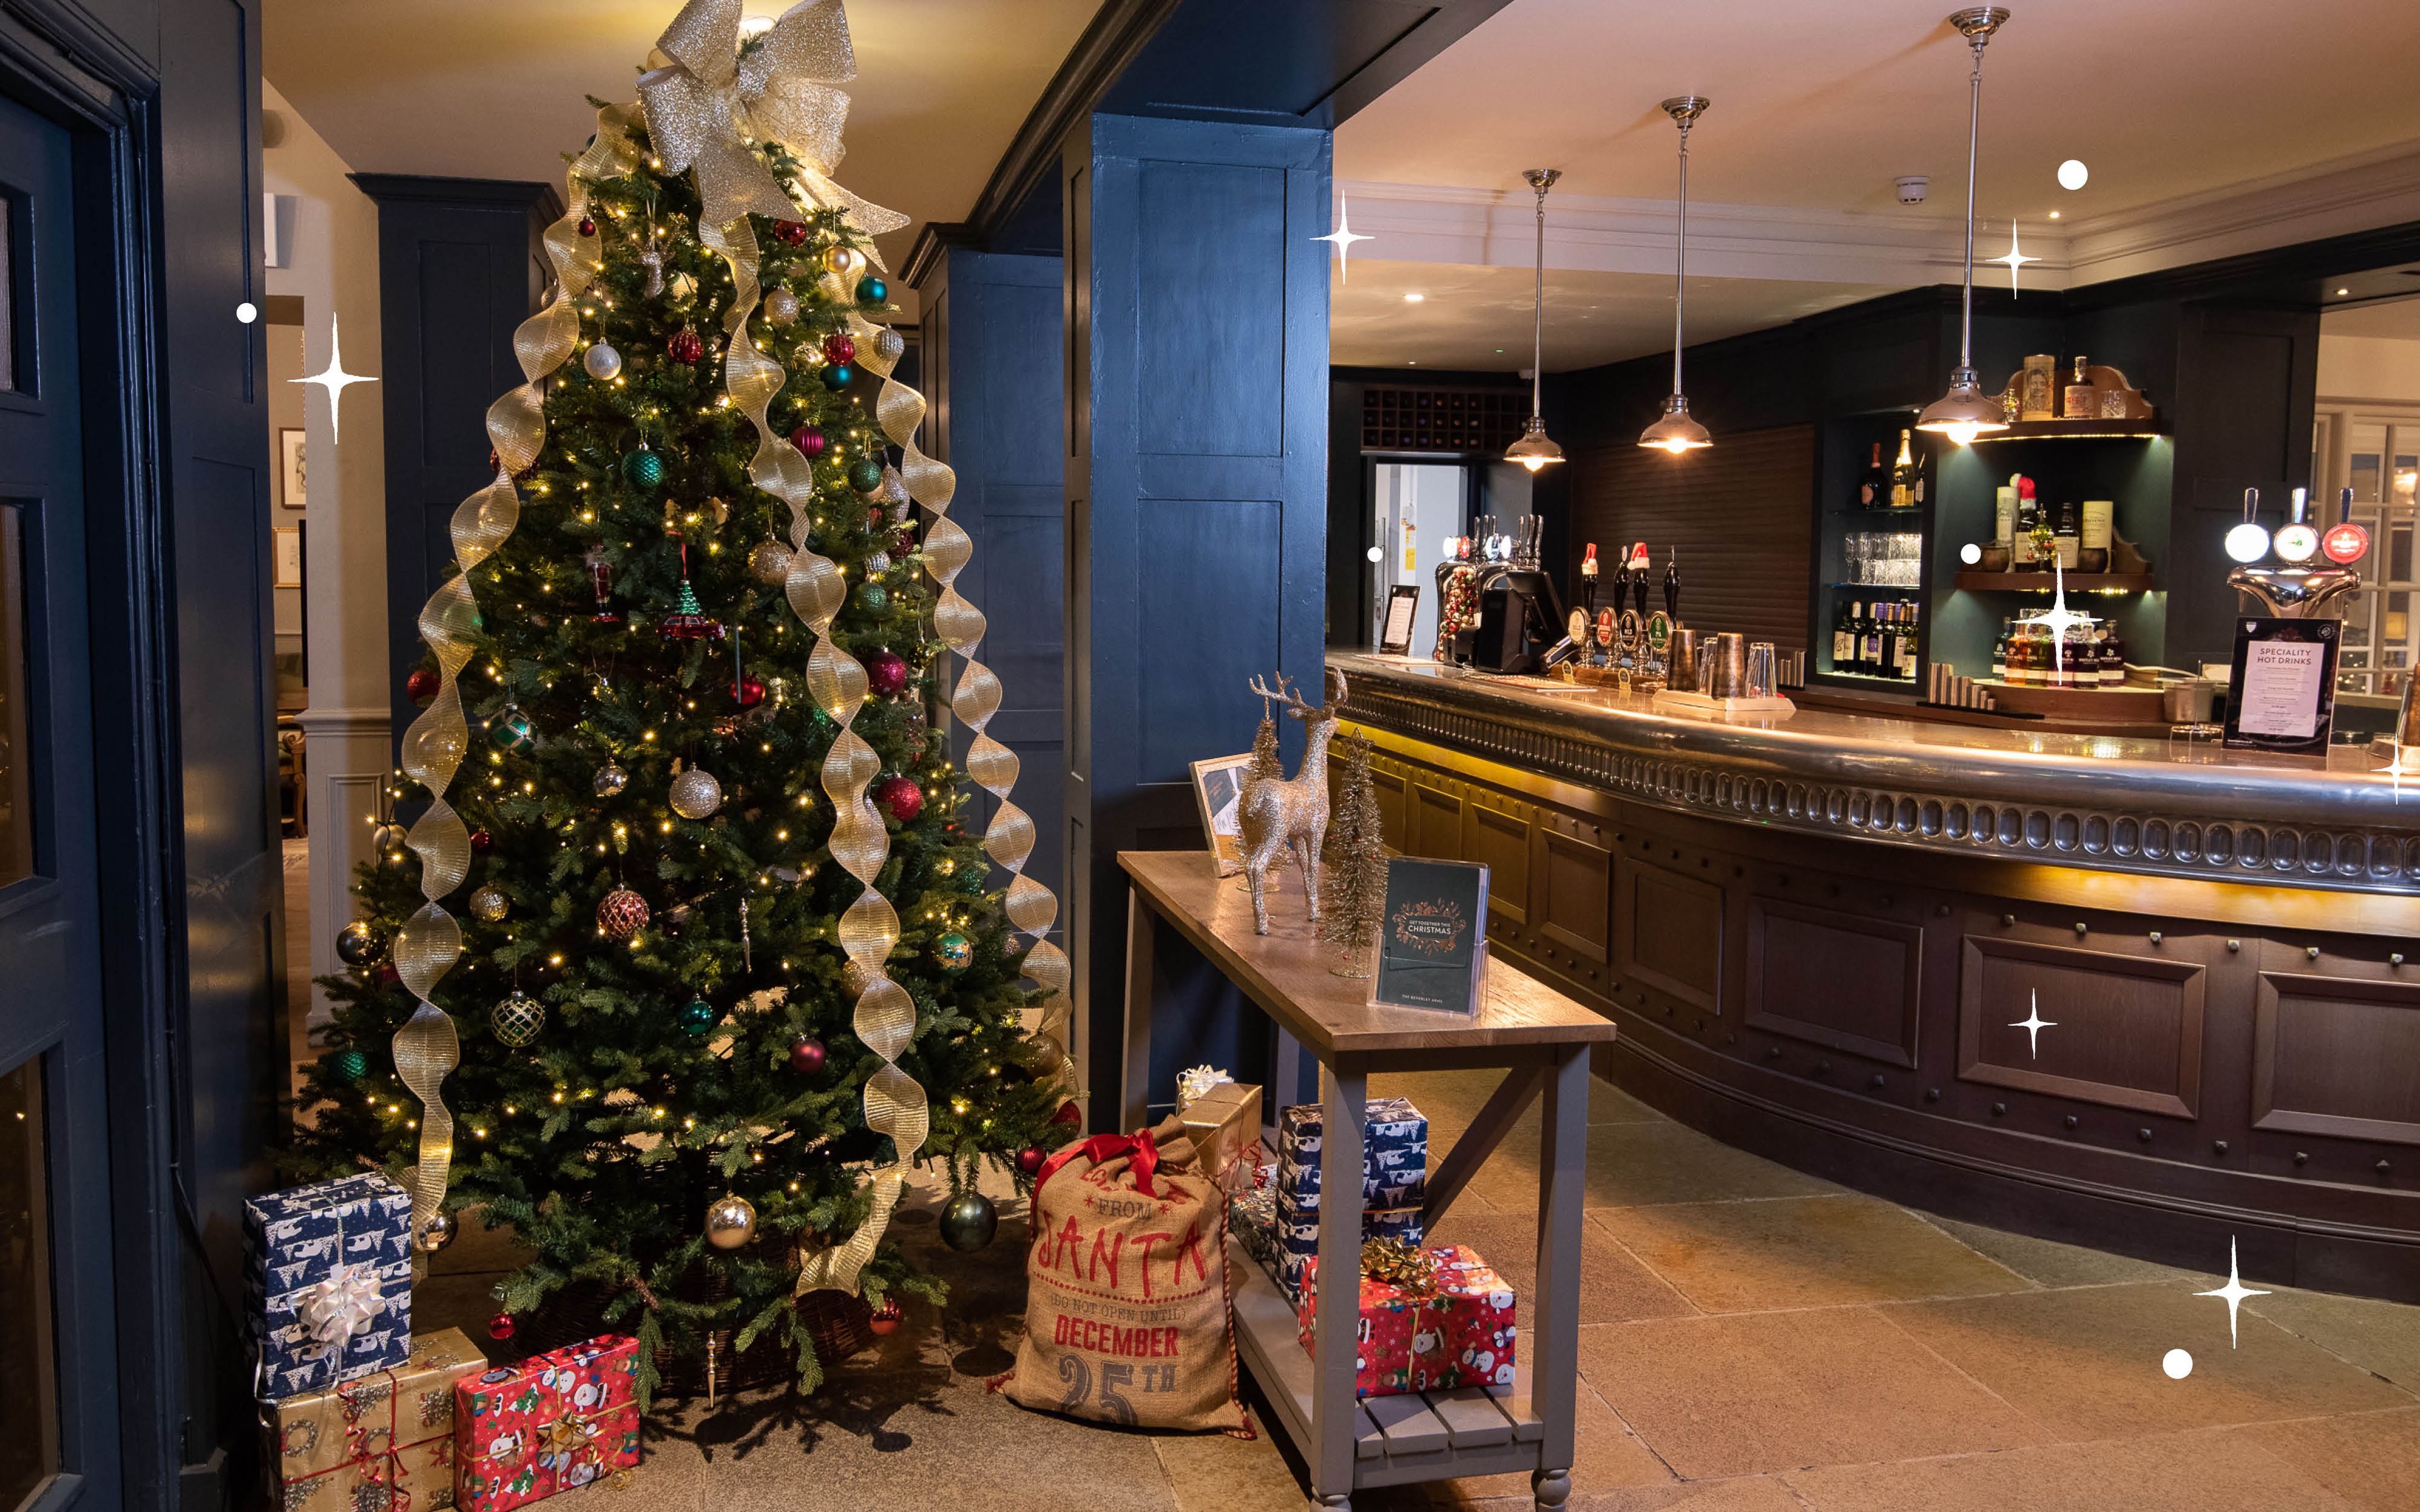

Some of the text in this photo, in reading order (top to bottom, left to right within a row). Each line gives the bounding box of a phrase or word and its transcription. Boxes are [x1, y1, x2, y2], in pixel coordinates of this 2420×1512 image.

[2260, 648, 2312, 656] SPECIALITY
[2278, 657, 2312, 665] DRINKS
[1408, 925, 1451, 935] CHRISTMAS
[1098, 1197, 1152, 1220] FROM
[1072, 1298, 1098, 1314] NOT
[1100, 1303, 1135, 1321] OPEN
[1140, 1307, 1186, 1323] UNTIL)
[1054, 1314, 1180, 1358] DECEMBER
